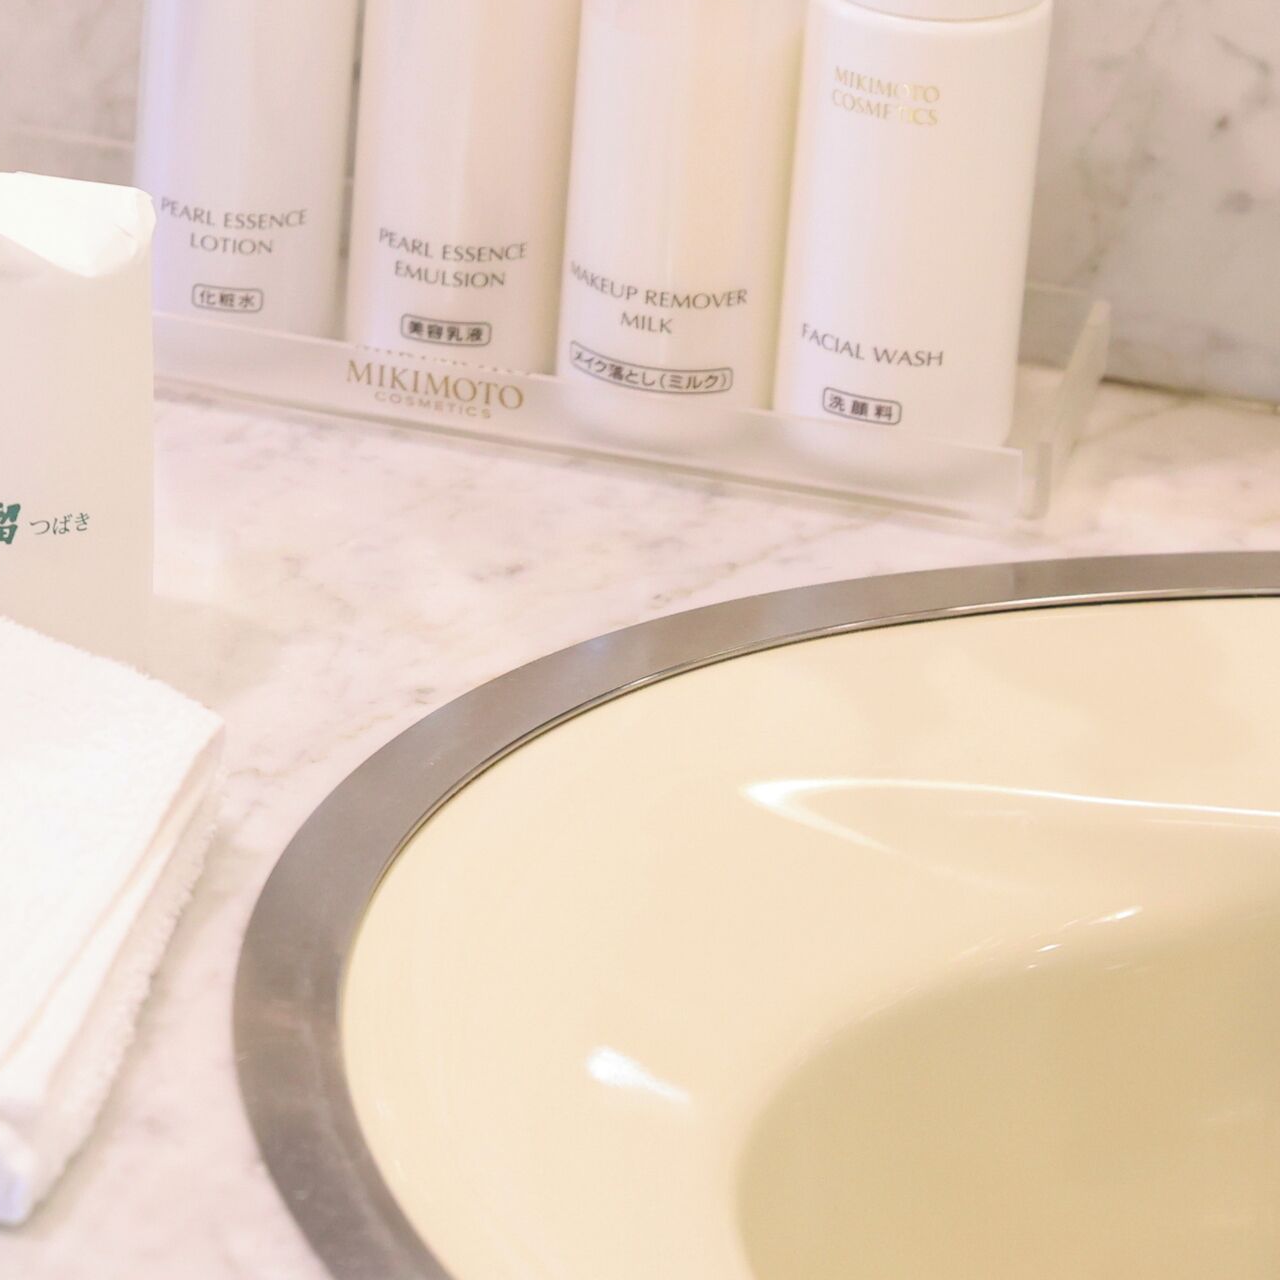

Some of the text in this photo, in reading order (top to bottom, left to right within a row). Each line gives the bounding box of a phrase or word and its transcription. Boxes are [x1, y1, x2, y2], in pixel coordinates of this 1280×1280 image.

[833, 64, 941, 104] MIKIMOTO
[831, 87, 940, 127] COSMETICS
[160, 196, 309, 230] PEARL ESSENCE
[189, 232, 274, 255] LOTION
[378, 227, 530, 263] PEARL ESSENCE
[394, 259, 507, 289] EMULSION
[570, 260, 749, 310] MAKEUP REMOVER
[199, 289, 256, 309] 化粧水
[408, 320, 484, 342] 美容乳液
[620, 311, 673, 335] MILK
[801, 322, 945, 367] FACIAL WASH
[345, 359, 524, 410] MIKIMOTO
[374, 390, 492, 419] COSMETICS
[828, 393, 893, 421] 洗顔料
[29, 512, 91, 536] つばき
